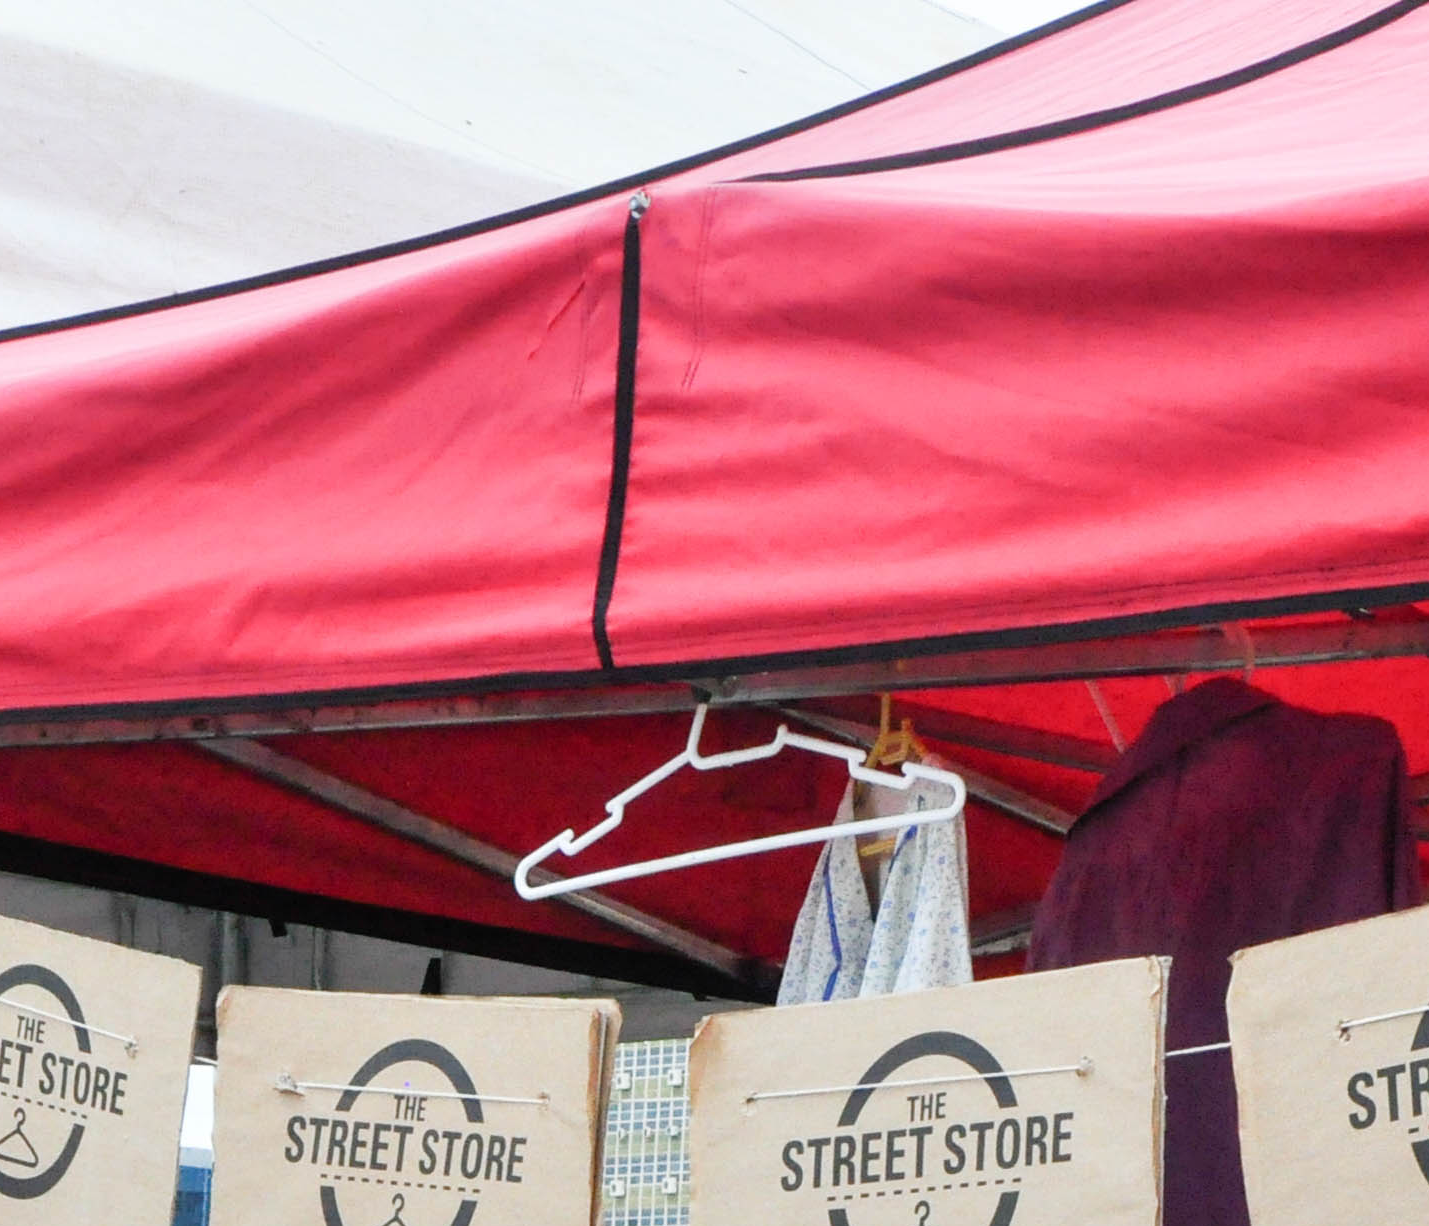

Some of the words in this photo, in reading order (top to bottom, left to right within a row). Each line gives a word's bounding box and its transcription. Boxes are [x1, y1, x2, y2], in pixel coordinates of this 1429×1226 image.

[17, 1016, 45, 1043] THE
[39, 1052, 128, 1116] STORE
[907, 1092, 947, 1122] THE
[393, 1094, 429, 1122] THE
[284, 1115, 414, 1172] STREET
[418, 1129, 527, 1183] STORE
[780, 1126, 933, 1192] STREET
[943, 1112, 1074, 1175] STORE
